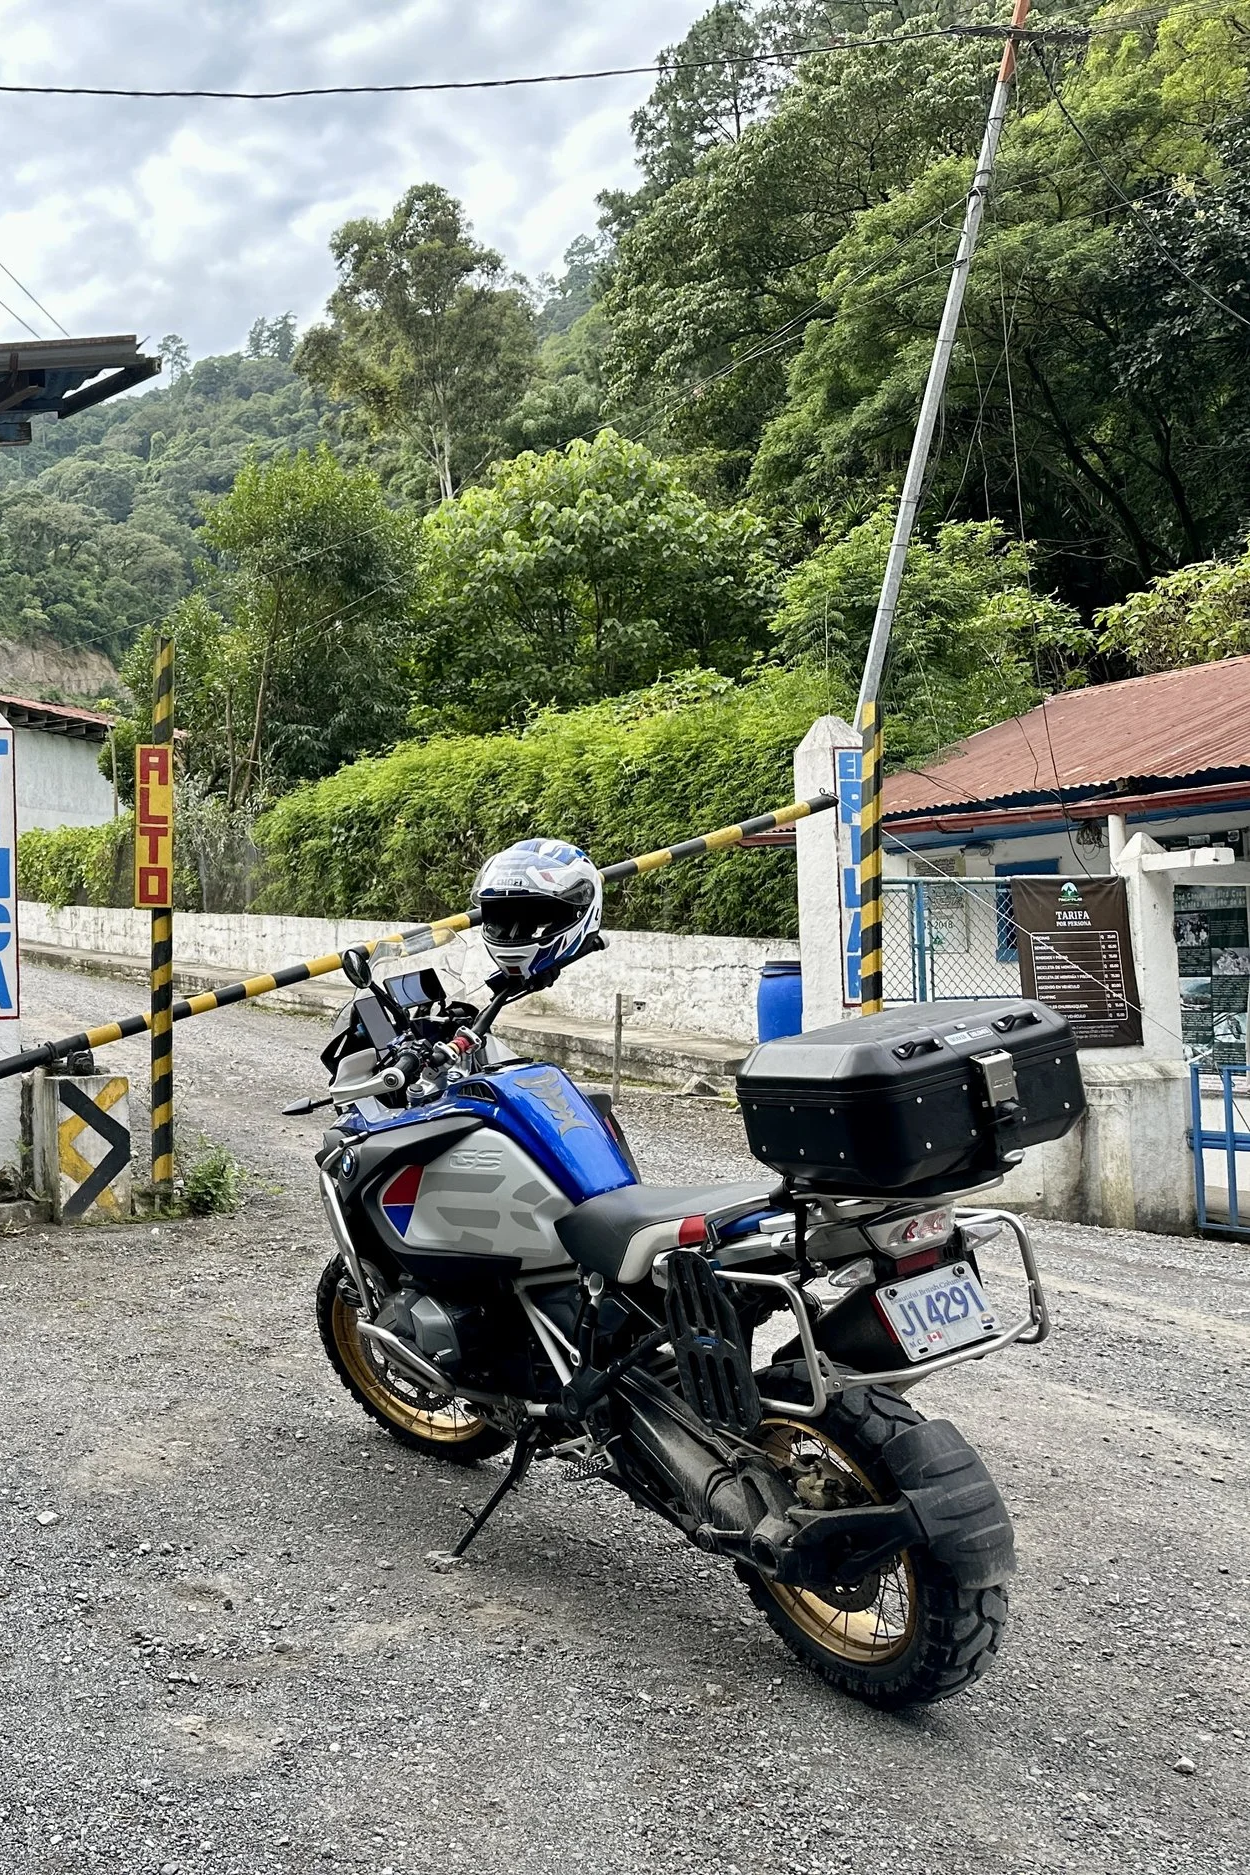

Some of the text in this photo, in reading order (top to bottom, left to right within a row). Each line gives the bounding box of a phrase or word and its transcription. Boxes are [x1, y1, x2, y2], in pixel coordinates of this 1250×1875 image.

[140, 748, 168, 904] ALTO
[1055, 910, 1090, 920] TARIFA
[450, 1150, 504, 1170] GS
[899, 1281, 985, 1336] J14291
